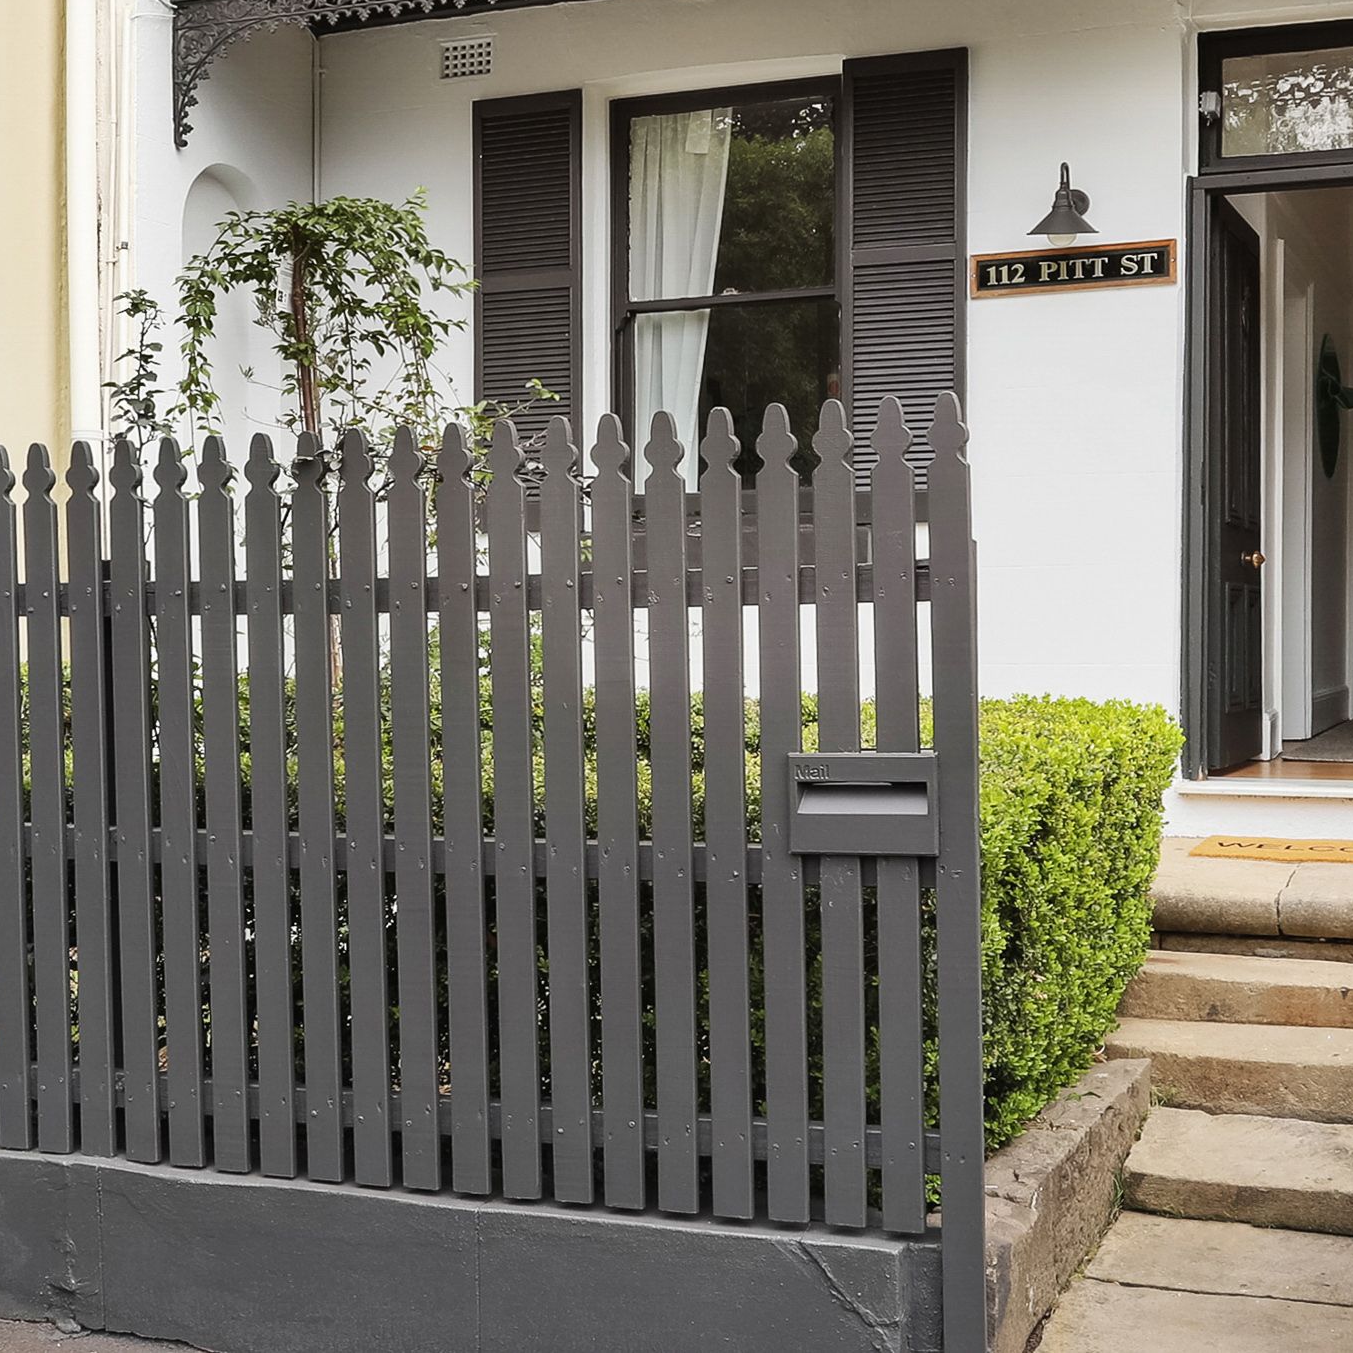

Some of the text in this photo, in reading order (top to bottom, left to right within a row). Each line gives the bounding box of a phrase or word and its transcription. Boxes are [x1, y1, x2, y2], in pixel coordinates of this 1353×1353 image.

[987, 253, 1158, 286] 112 PITT ST
[794, 764, 830, 780] Mail
